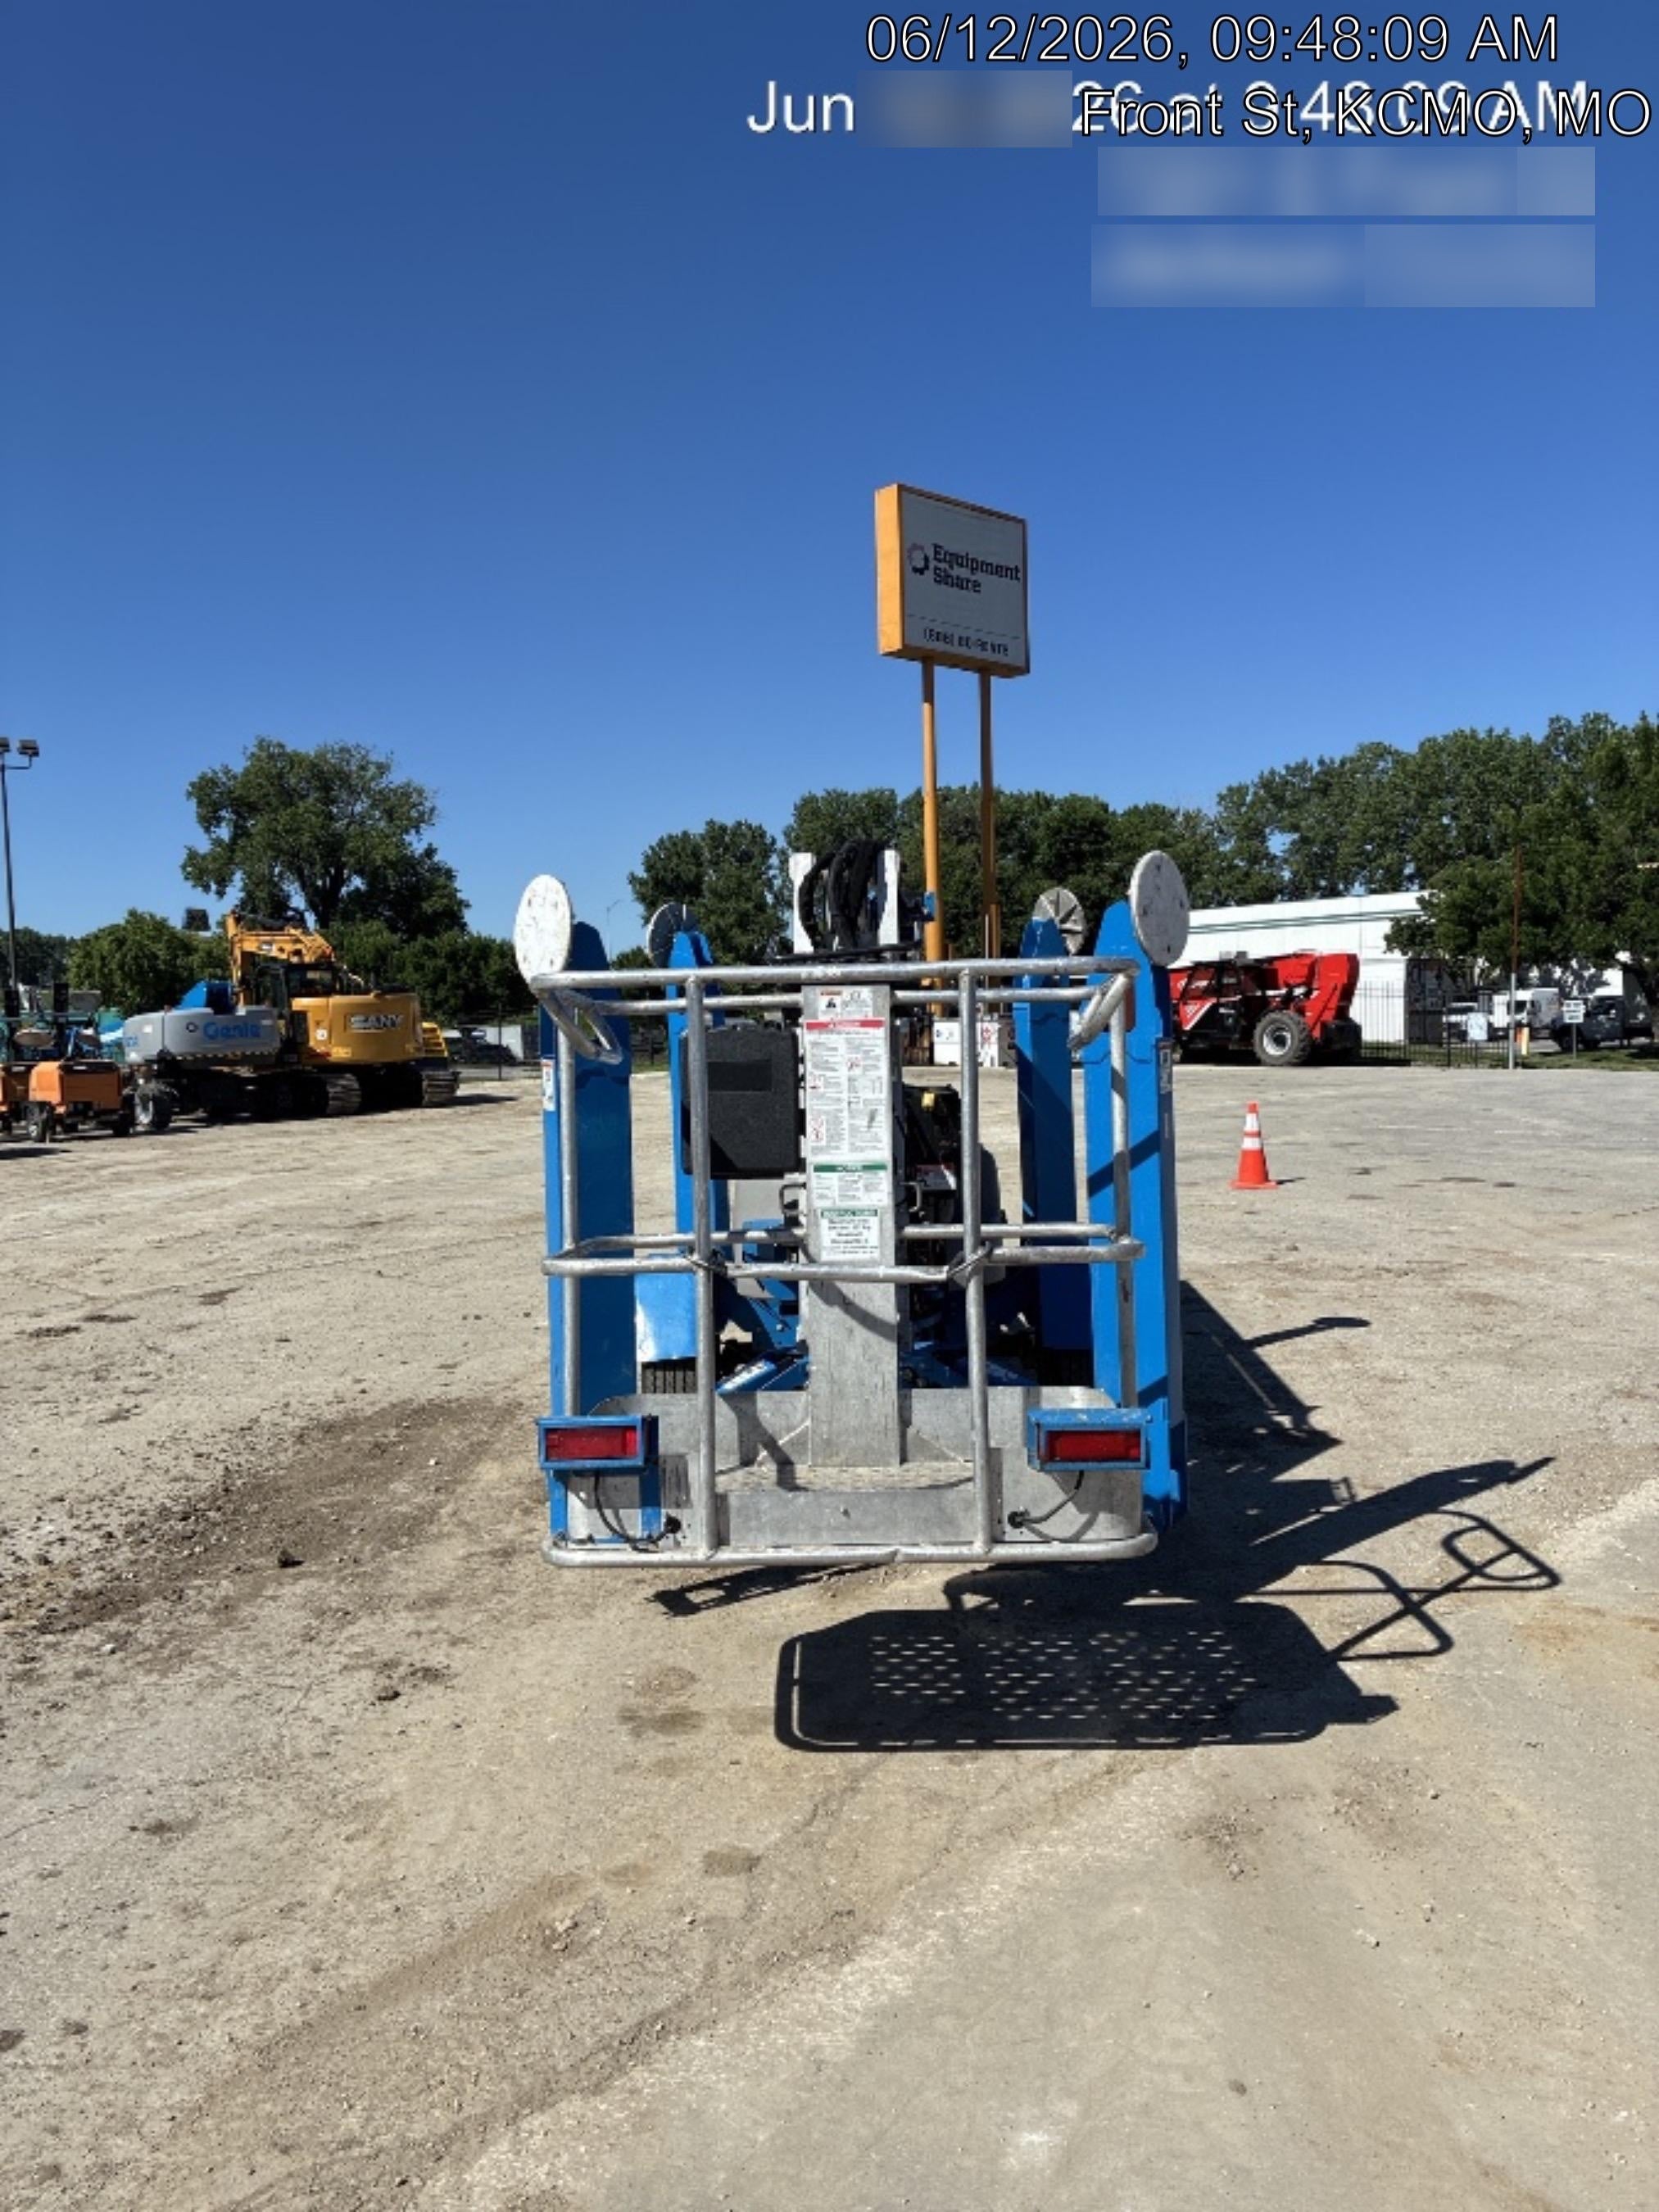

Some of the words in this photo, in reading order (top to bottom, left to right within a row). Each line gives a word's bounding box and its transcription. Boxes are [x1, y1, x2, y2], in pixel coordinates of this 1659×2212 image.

[932, 543, 1021, 582] Equipment
[934, 565, 981, 594] Share
[204, 1022, 261, 1040] Genie
